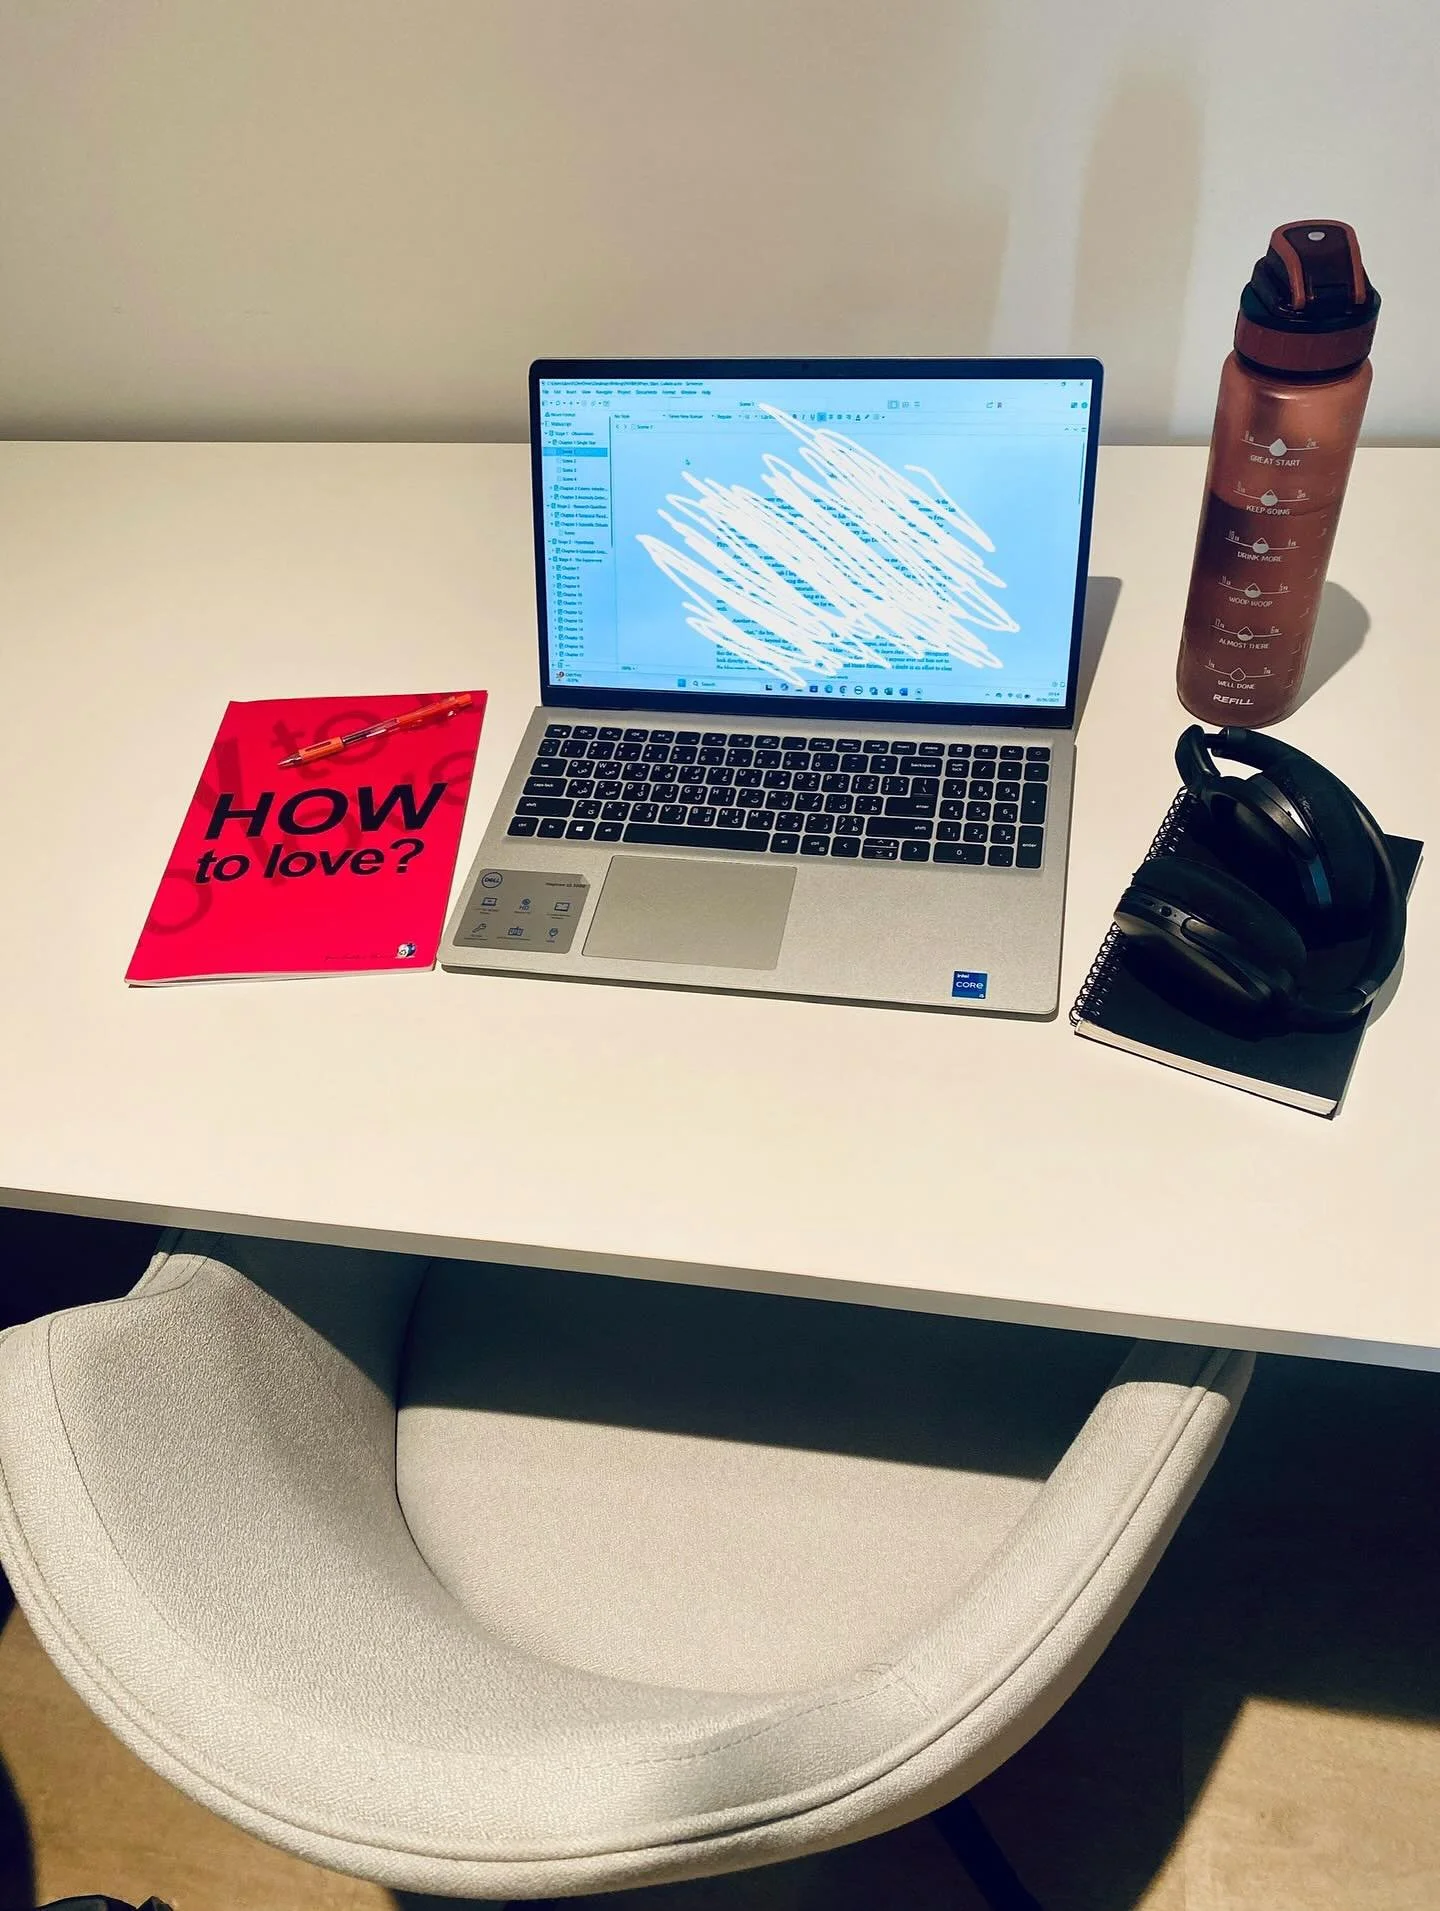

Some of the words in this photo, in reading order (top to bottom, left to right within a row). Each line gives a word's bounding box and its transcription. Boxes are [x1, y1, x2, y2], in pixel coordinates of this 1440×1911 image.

[1250, 455, 1273, 465] GREAT
[1247, 505, 1265, 513] KEEP
[1238, 552, 1260, 561] DRINK
[1229, 597, 1249, 605] WOOP
[1219, 639, 1246, 648] ALMOST
[1213, 694, 1254, 705] REFILL
[204, 783, 448, 840] HOW
[193, 848, 251, 885] to
[263, 838, 425, 879] love?
